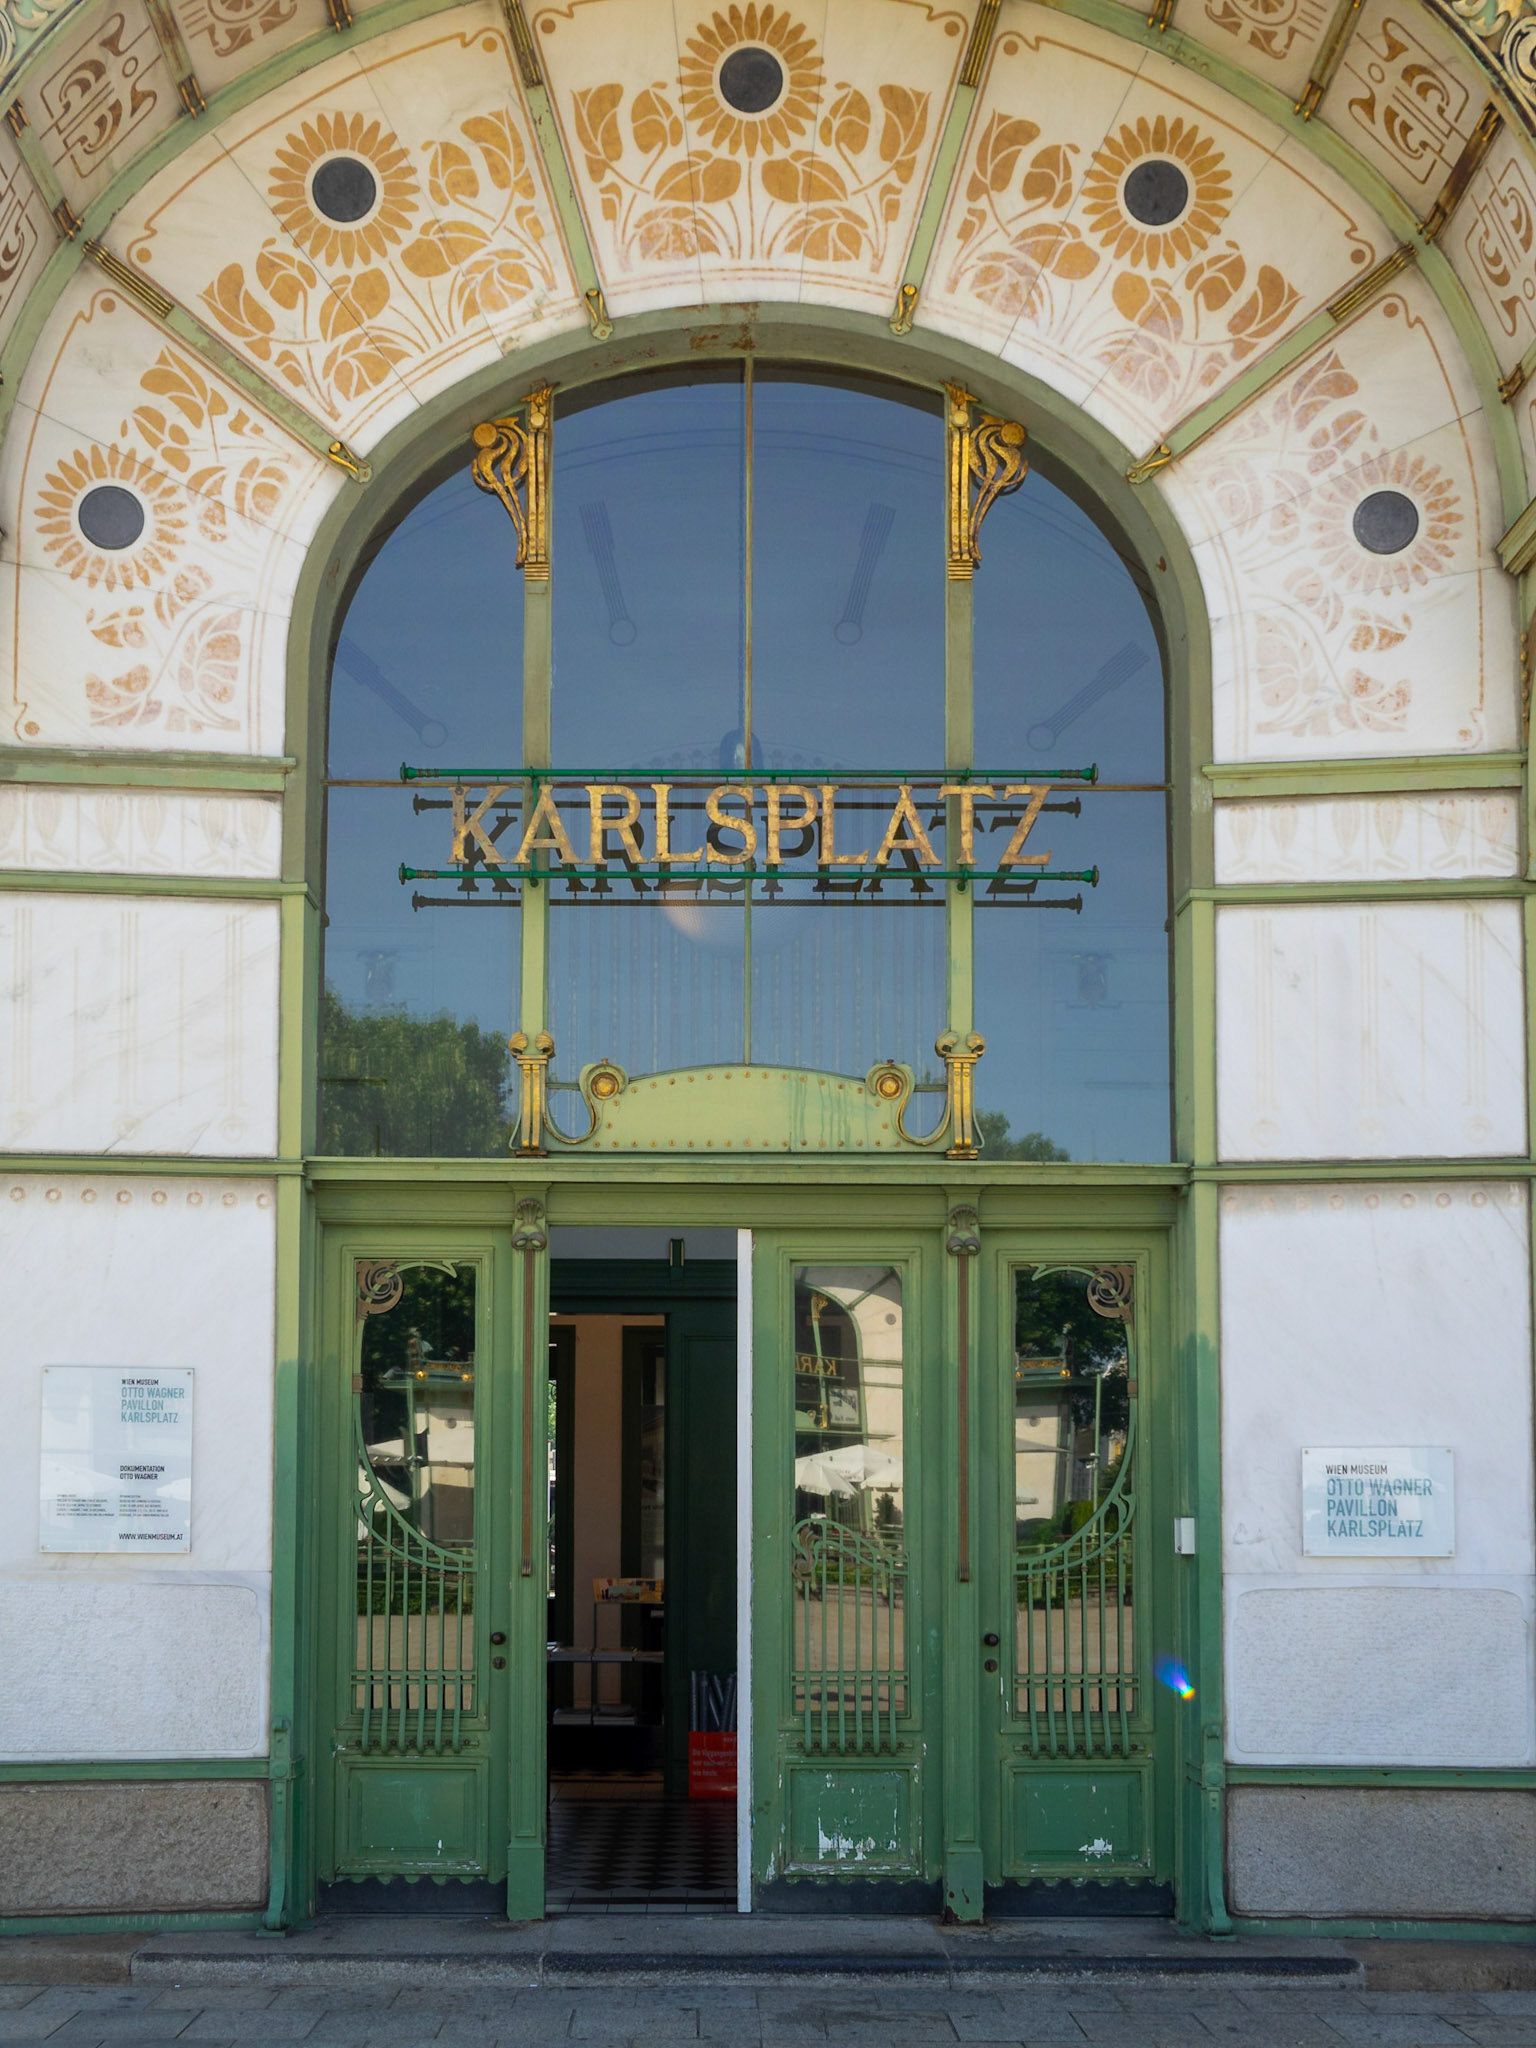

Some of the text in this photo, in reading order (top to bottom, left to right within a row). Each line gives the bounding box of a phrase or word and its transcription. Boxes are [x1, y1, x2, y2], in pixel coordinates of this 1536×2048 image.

[448, 783, 1053, 867] KARLSPLATZ
[121, 1378, 135, 1386] WIEN
[121, 1386, 185, 1399] OTTO WAGNER
[121, 1399, 164, 1411] PAVILLON
[121, 1411, 179, 1423] KARLSPLATZ
[1325, 1464, 1388, 1475] WIEN MUSEUM
[1326, 1478, 1433, 1496] OTTO WAGNER
[1327, 1498, 1398, 1517] PAVILLON
[1327, 1519, 1424, 1538] KARLSPLATZ
[119, 1533, 184, 1541] WWW.WIENMUSEUM.AT
